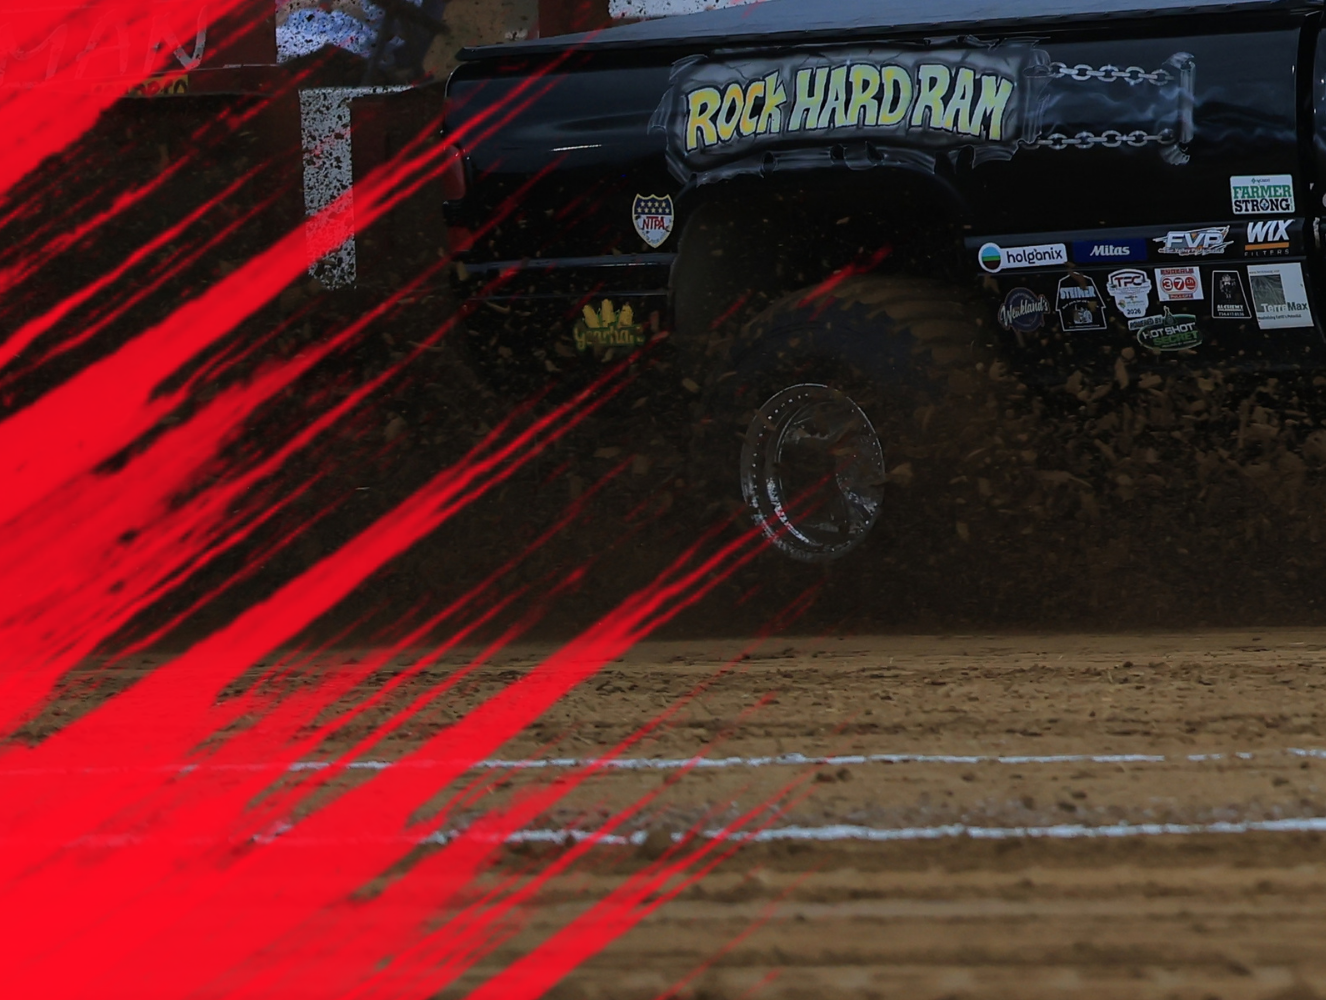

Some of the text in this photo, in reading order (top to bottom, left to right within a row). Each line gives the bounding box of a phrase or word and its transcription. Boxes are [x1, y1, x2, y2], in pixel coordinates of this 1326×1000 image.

[685, 63, 1014, 152] ROCK HARD RAM
[1233, 185, 1292, 200] FARMER
[1234, 198, 1290, 213] STRONG
[642, 216, 666, 230] NTPA
[1246, 219, 1296, 244] WIX
[1166, 231, 1224, 248] FVP
[1007, 247, 1063, 264] holganix
[1090, 245, 1131, 257] Mitas
[1261, 302, 1309, 313] TerraMax
[1142, 327, 1164, 340] HOT
[1153, 330, 1200, 345] SECRET
